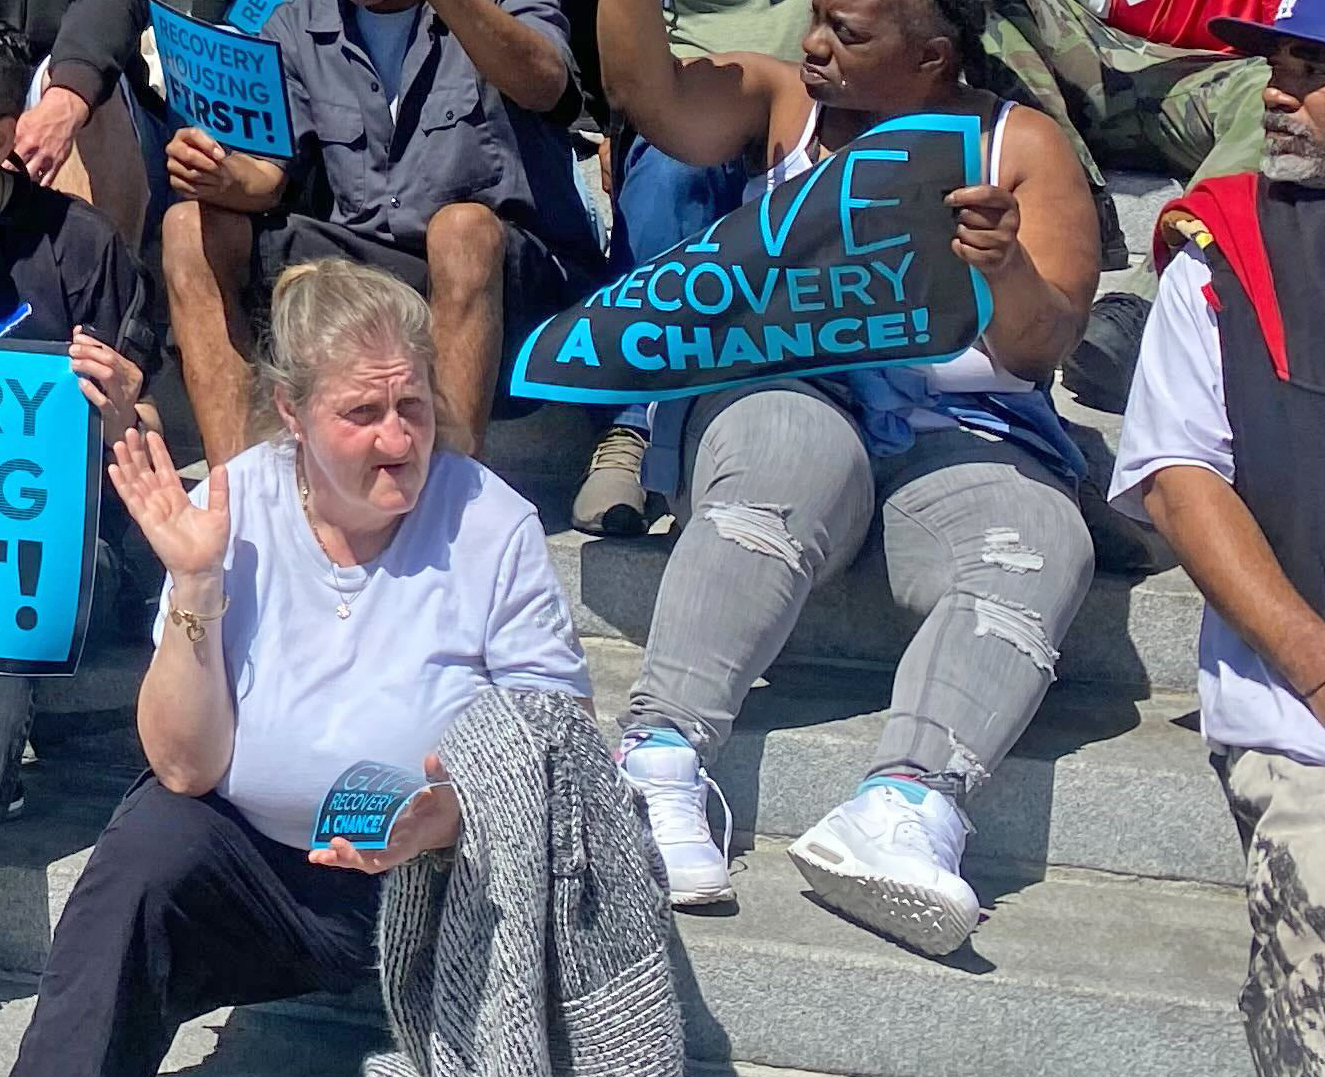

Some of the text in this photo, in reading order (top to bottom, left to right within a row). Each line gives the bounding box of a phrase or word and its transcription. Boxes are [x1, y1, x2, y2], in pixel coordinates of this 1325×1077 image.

[159, 16, 265, 75] RECOVERY
[164, 49, 270, 106] HOUSING
[171, 79, 276, 143] FIRST!
[685, 150, 912, 258] IVE
[585, 250, 915, 315] RECOVERY
[556, 307, 931, 371] A CHANCE!
[329, 792, 398, 812] RECOVERY
[344, 764, 417, 793] GIVE
[321, 814, 387, 834] A CHANCE!
